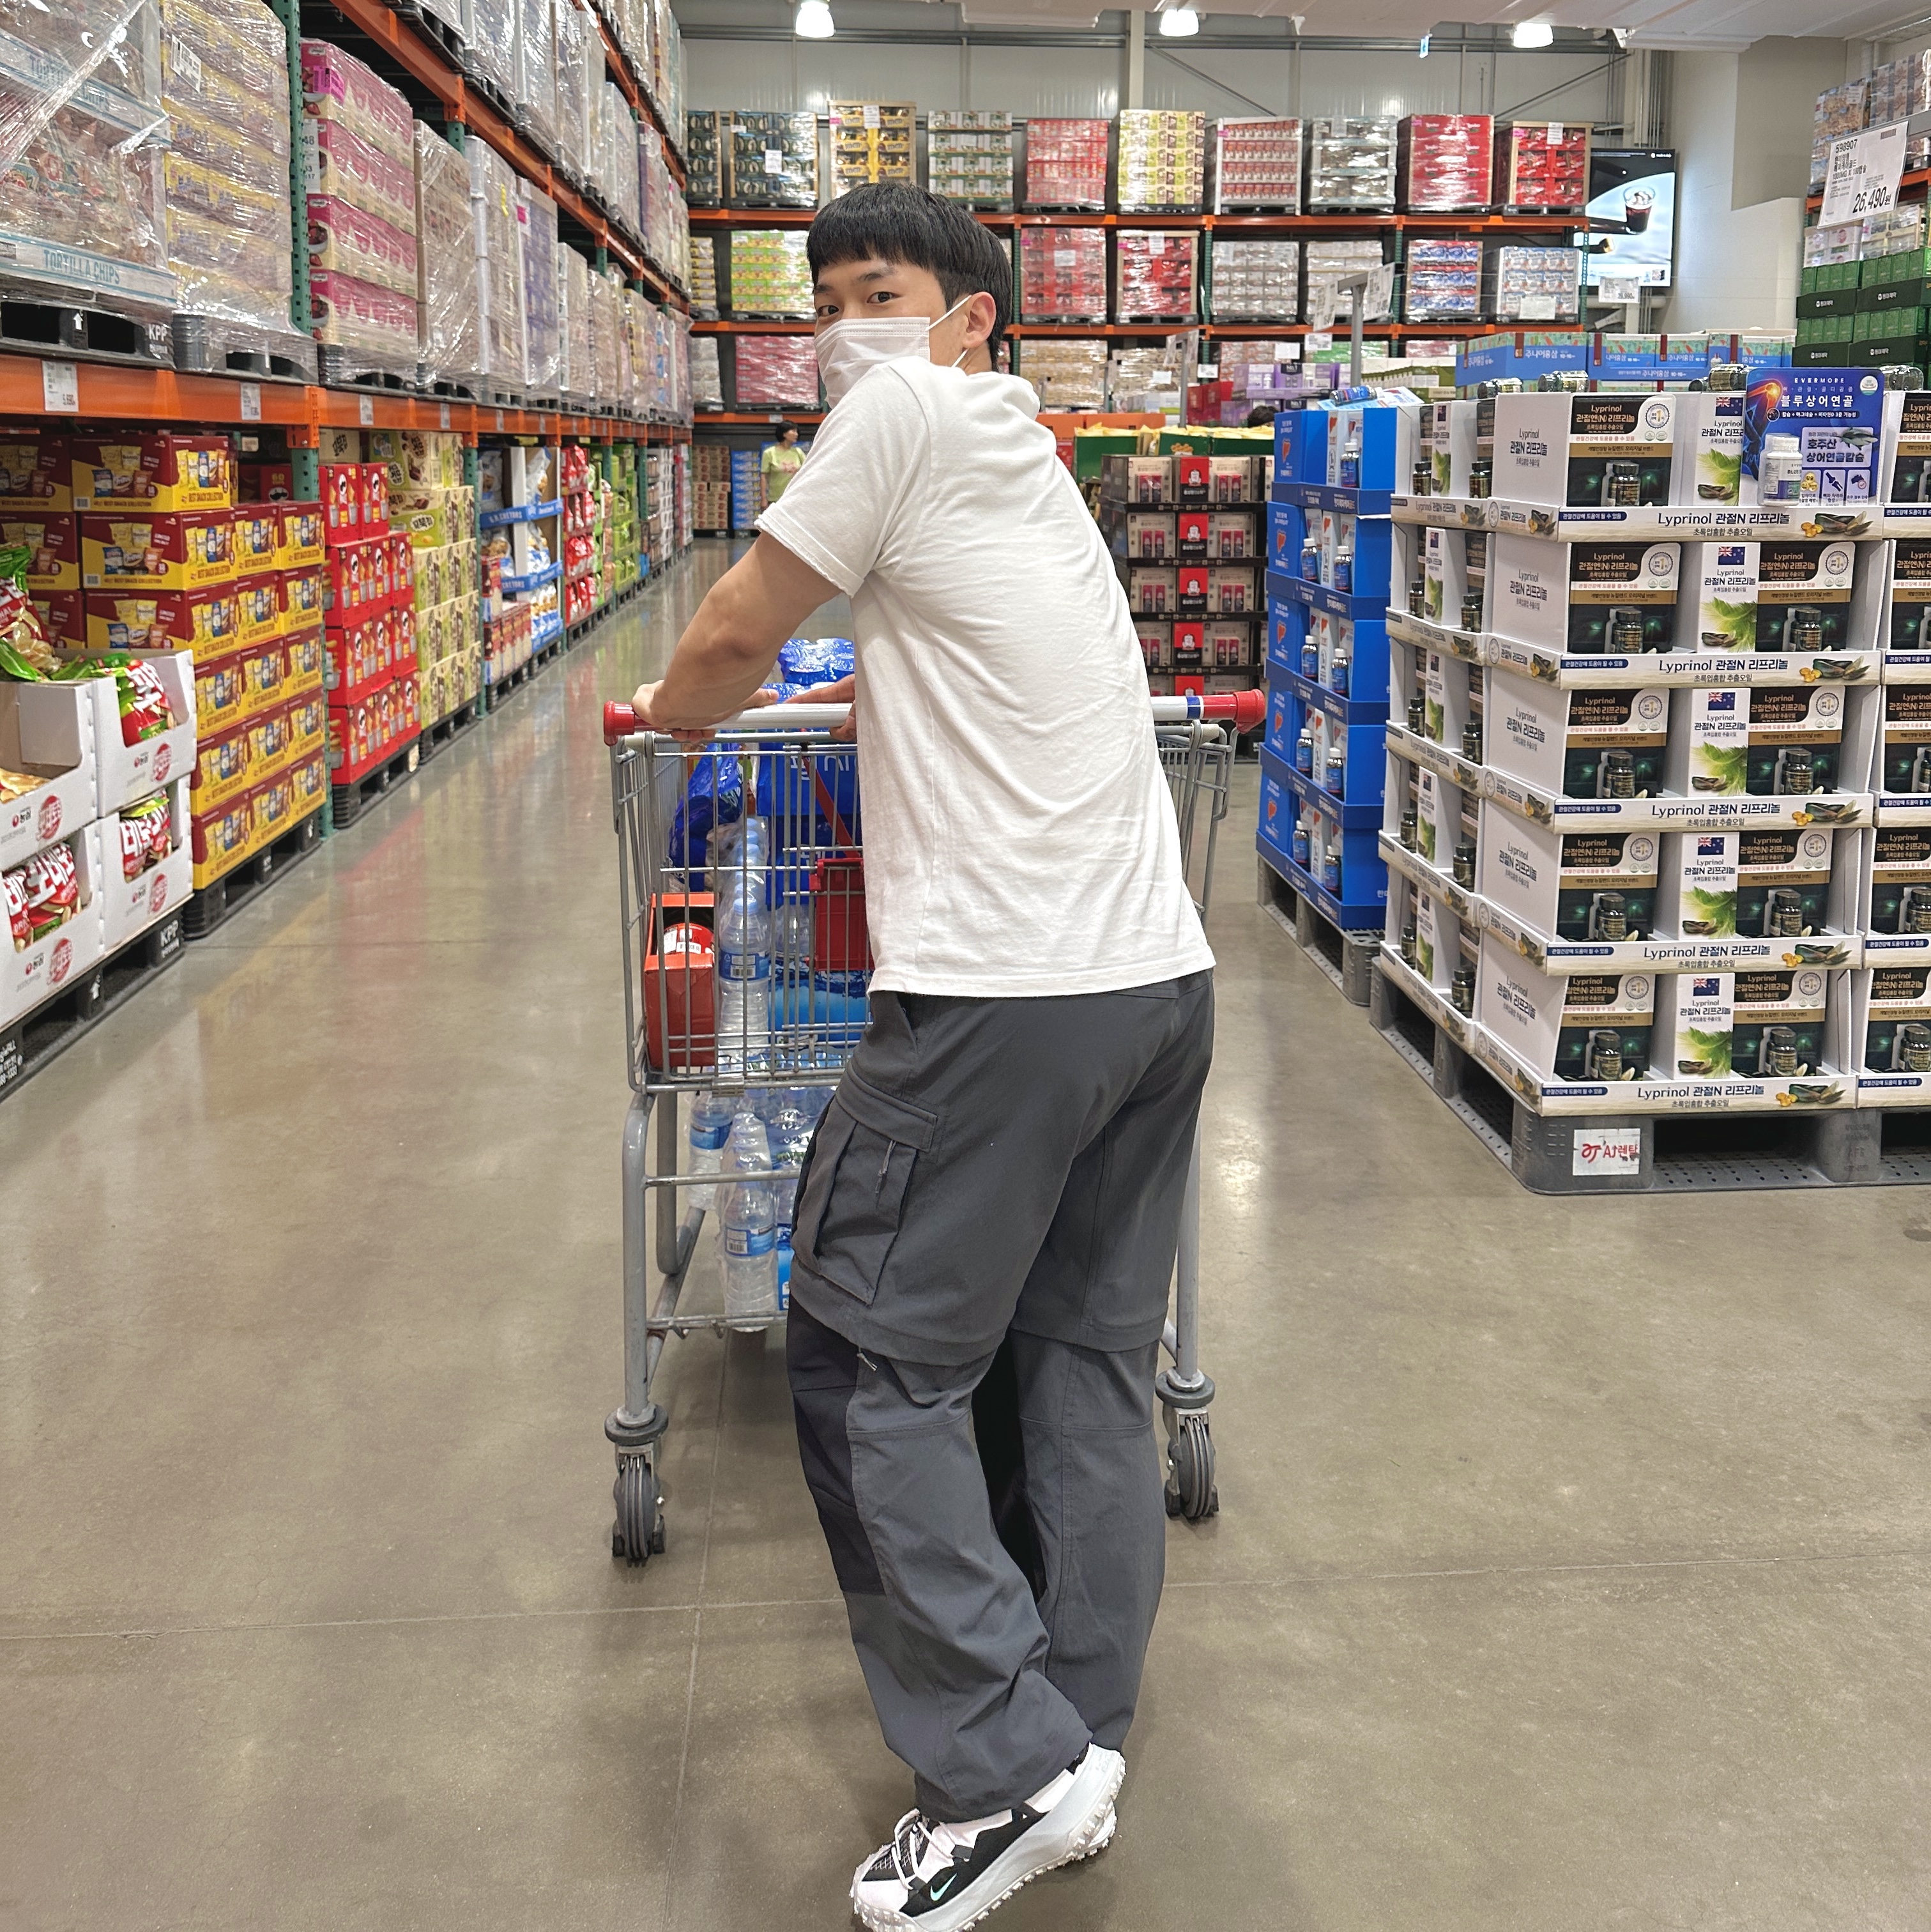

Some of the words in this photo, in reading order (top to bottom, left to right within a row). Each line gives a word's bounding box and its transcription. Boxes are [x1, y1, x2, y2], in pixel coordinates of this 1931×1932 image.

[1852, 186, 1891, 213] 26,490원
[43, 249, 92, 279] TORTILLA
[93, 261, 120, 285] CHIPS
[148, 323, 168, 342] KPP
[1780, 395, 1854, 408] 블루상어연골
[1591, 404, 1622, 413] Lyprinol
[1608, 414, 1635, 423] 리프리놀
[1519, 428, 1539, 440] Lyprinol
[1807, 438, 1837, 450] 호주산
[1806, 452, 1865, 463] 상어연골칼슘
[1658, 512, 1712, 526] Lyprinol
[1716, 512, 1746, 525] 관절N
[1749, 512, 1790, 525] 리프리놀
[1693, 528, 1725, 536] 초록입홍합
[1727, 527, 1753, 536] 추출오일
[1594, 553, 1625, 561] Lyprinol
[1774, 553, 1804, 561] Lyprinol
[1611, 562, 1638, 571] 리프리놀
[1790, 561, 1815, 570] 리프리놀
[1518, 569, 1539, 582] Lyprinol
[1728, 577, 1756, 585] 리프리놀
[1659, 659, 1712, 673] Lyprinol
[1716, 659, 1745, 670] 관절N
[1748, 659, 1789, 670] 리프리놀
[1694, 674, 1726, 682] 초록입홍합
[1727, 674, 1753, 682] 추출오일
[1585, 697, 1615, 705] Lyprinol
[1764, 694, 1794, 703] Lyprinol
[1601, 706, 1628, 714] 리프리놀
[1780, 703, 1806, 712] 리프리놀
[1516, 707, 1537, 723] Lyprinol
[1718, 722, 1746, 730] 리프리놀
[1652, 804, 1704, 818] Lyprinol
[1708, 804, 1738, 815] 관절N
[1741, 803, 1780, 814] 리프리놀
[1753, 836, 1782, 845] Lyprinol
[1889, 834, 1918, 842] Lyprinol
[1577, 839, 1607, 847] Lyprinol
[1507, 841, 1528, 860] Lyprinol
[1594, 848, 1620, 856] 리프리놀
[1769, 845, 1795, 854] 리프리놀
[1684, 867, 1705, 875] 관절N
[1707, 866, 1736, 875] 리프리놀
[161, 921, 179, 947] KPP
[1644, 946, 1695, 960] Lyprinol
[1699, 946, 1729, 957] 관절N
[1731, 944, 1771, 956] 리프리놀
[1748, 974, 1777, 983] Lyprinol
[1506, 976, 1528, 997] Lyprinol
[1898, 981, 1923, 990] 리프리놀
[1680, 1008, 1701, 1016] 관절N
[1703, 1007, 1730, 1016] 리프리놀
[1638, 1086, 1690, 1100] Lyprinol
[1693, 1086, 1722, 1096] 관절N
[1725, 1085, 1764, 1096] 리프리놀
